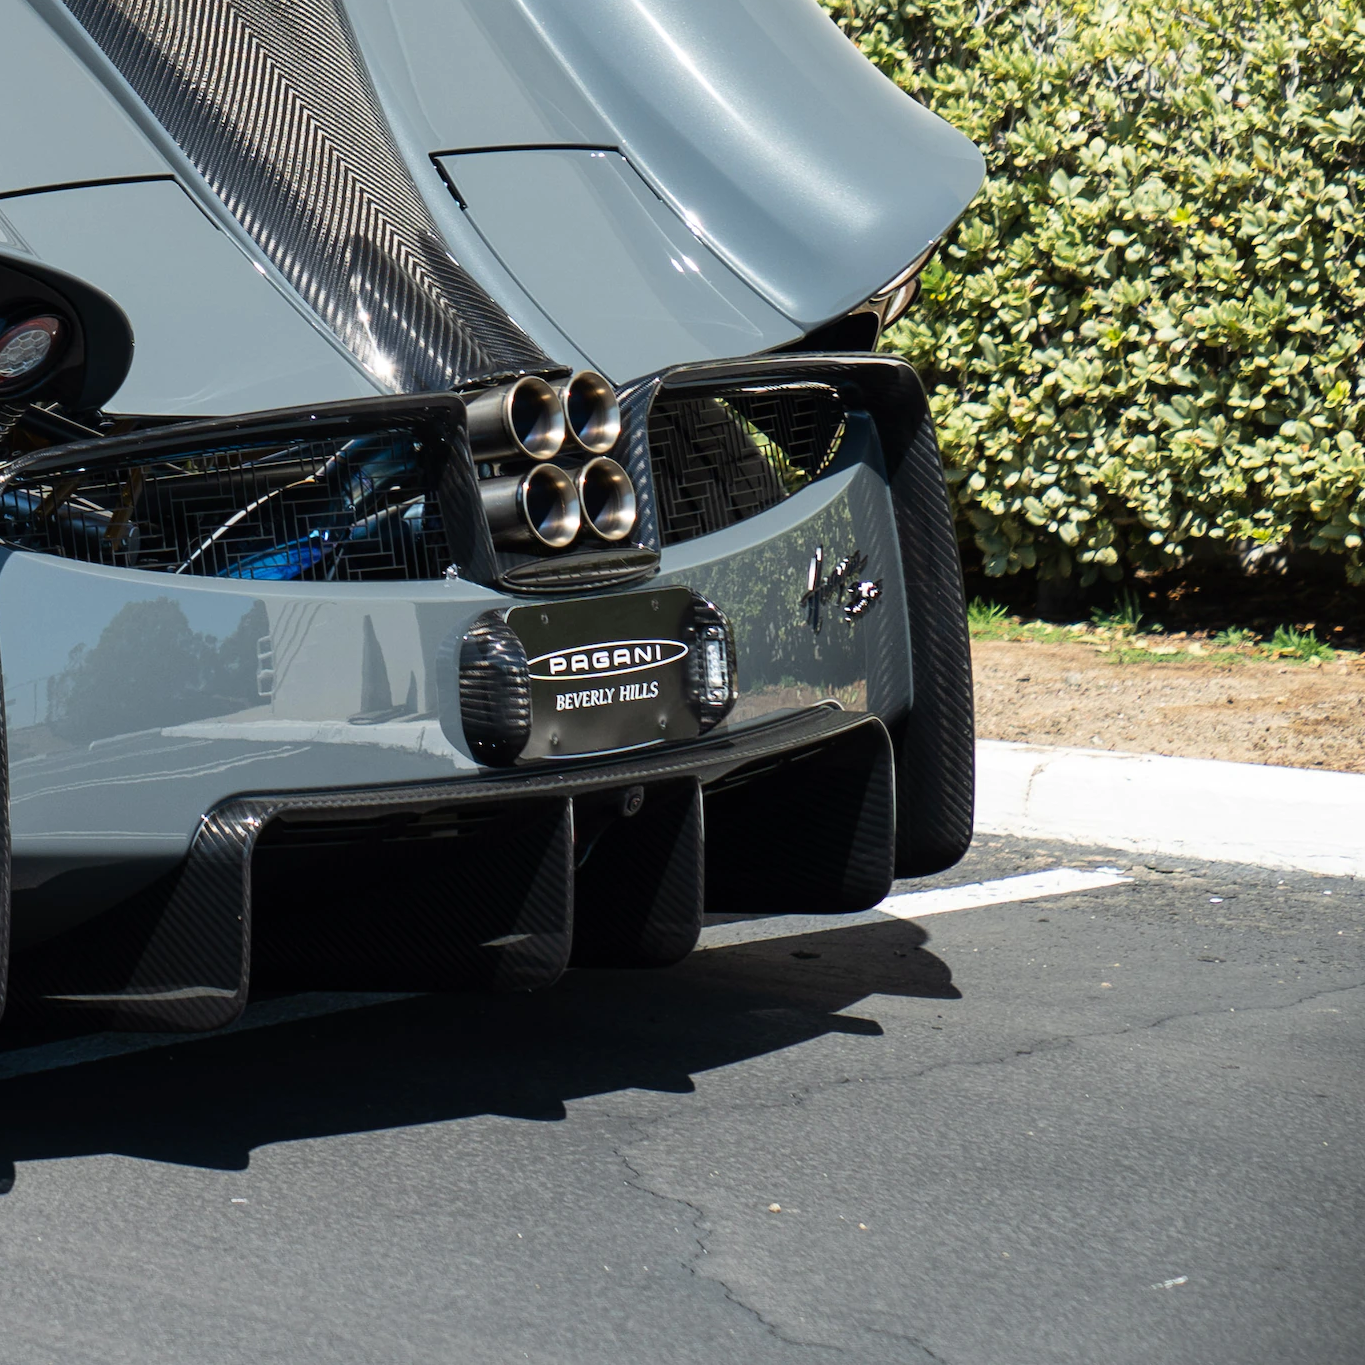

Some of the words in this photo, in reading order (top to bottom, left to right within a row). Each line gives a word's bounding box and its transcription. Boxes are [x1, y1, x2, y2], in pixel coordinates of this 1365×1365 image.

[549, 644, 662, 675] PAGANI
[556, 687, 615, 712] BEVERLY
[618, 682, 660, 702] HILLS
